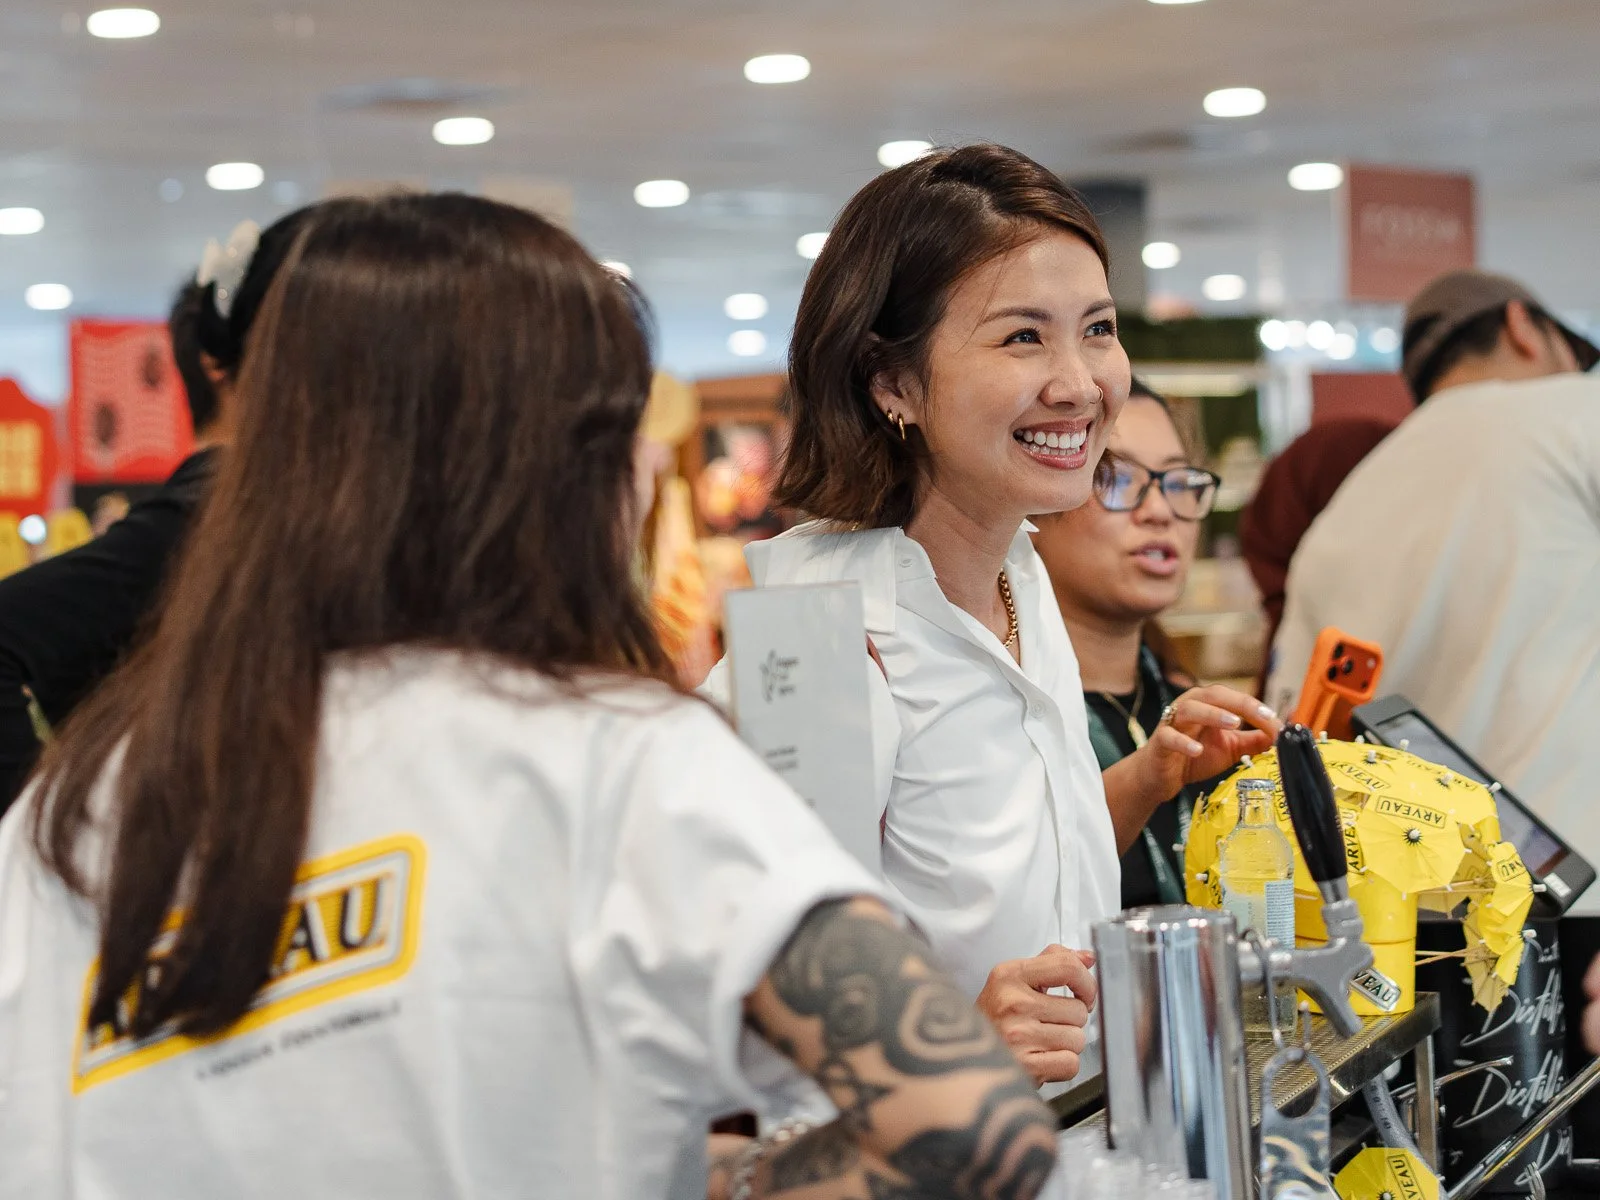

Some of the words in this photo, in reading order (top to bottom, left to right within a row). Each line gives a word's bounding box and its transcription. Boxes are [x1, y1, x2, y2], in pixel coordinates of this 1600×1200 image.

[1380, 800, 1443, 824] ARVEAU
[1353, 969, 1394, 1002] VEAU
[1392, 1159, 1419, 1199] VEAU
